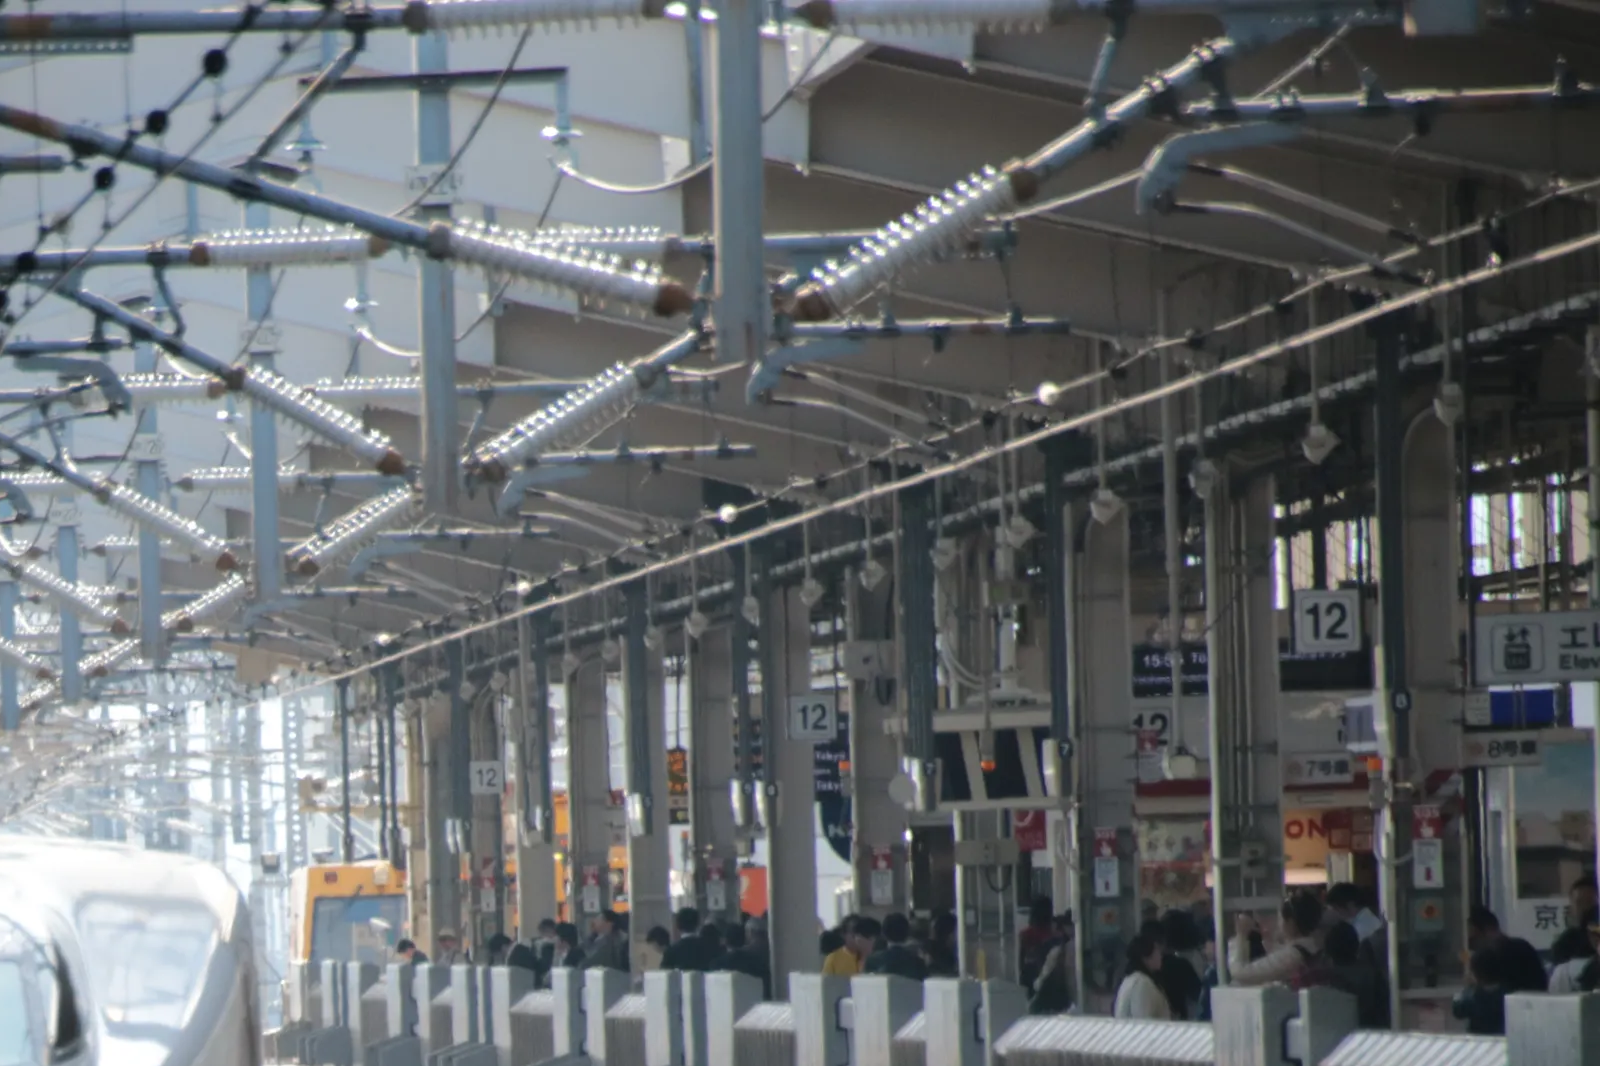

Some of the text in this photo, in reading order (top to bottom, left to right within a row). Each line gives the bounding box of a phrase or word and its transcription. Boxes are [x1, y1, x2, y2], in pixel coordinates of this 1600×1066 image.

[1305, 601, 1350, 641] 12
[799, 704, 828, 731] 12
[476, 768, 497, 787] 12
